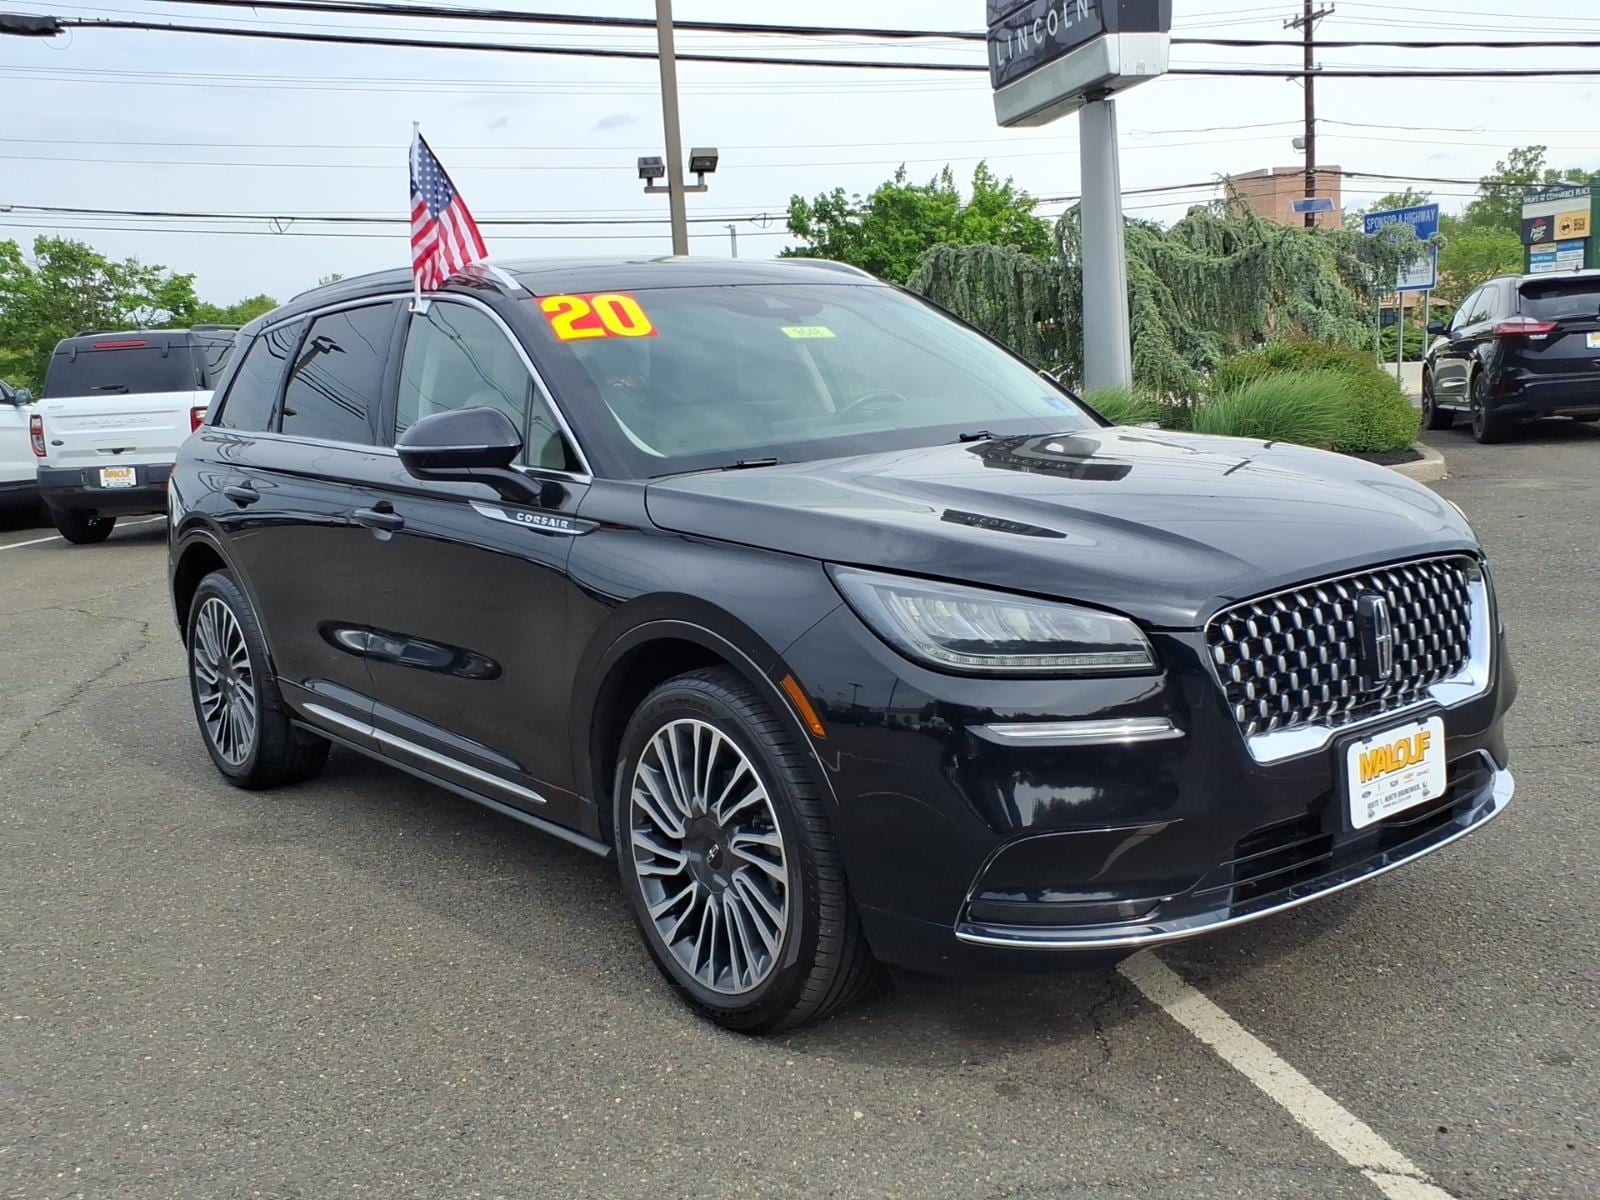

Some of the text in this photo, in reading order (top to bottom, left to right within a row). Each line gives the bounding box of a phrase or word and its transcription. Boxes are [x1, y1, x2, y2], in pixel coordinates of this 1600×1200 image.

[996, 0, 1089, 66] LINCOLN
[1404, 208, 1436, 224] HIGHWAY
[540, 294, 652, 340] 20
[516, 512, 569, 529] CORSAIR
[1359, 730, 1431, 783] MALOUF
